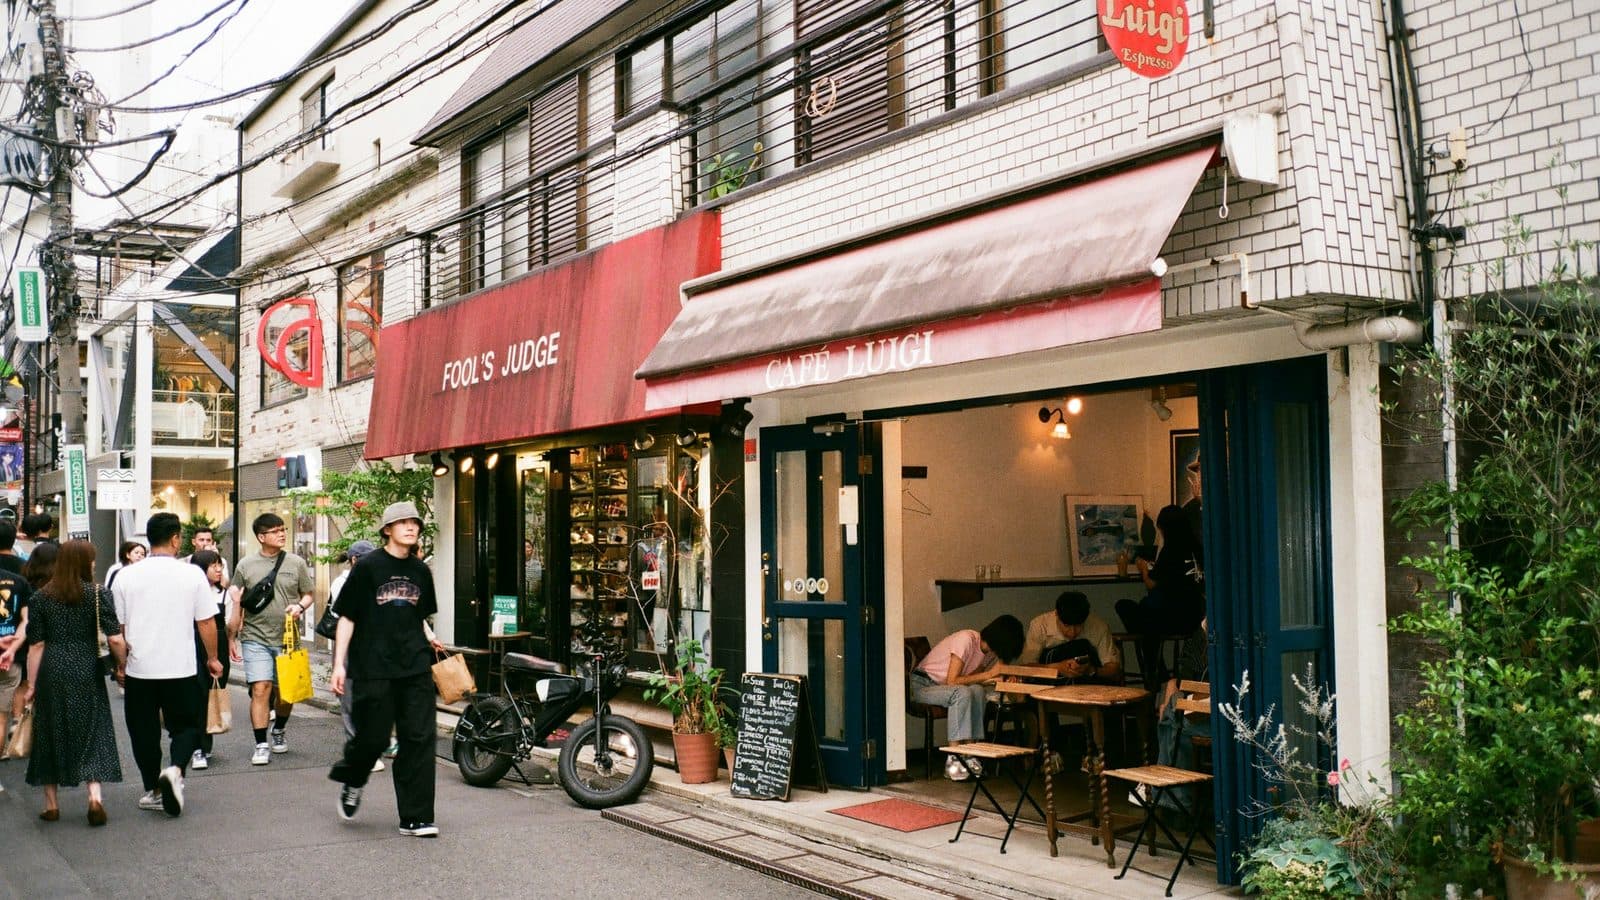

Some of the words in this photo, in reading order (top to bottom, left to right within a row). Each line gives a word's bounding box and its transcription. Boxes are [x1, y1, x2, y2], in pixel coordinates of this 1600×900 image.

[1102, 0, 1188, 54] Luigi
[1121, 48, 1174, 70] Espresso
[25, 281, 34, 306] GREEN
[442, 350, 495, 391] FOOL'S
[501, 331, 560, 377] JUDGE
[765, 344, 831, 389] CAFÉ
[845, 330, 934, 378] LUIGI
[71, 461, 82, 490] GREEN
[73, 491, 85, 513] SEED
